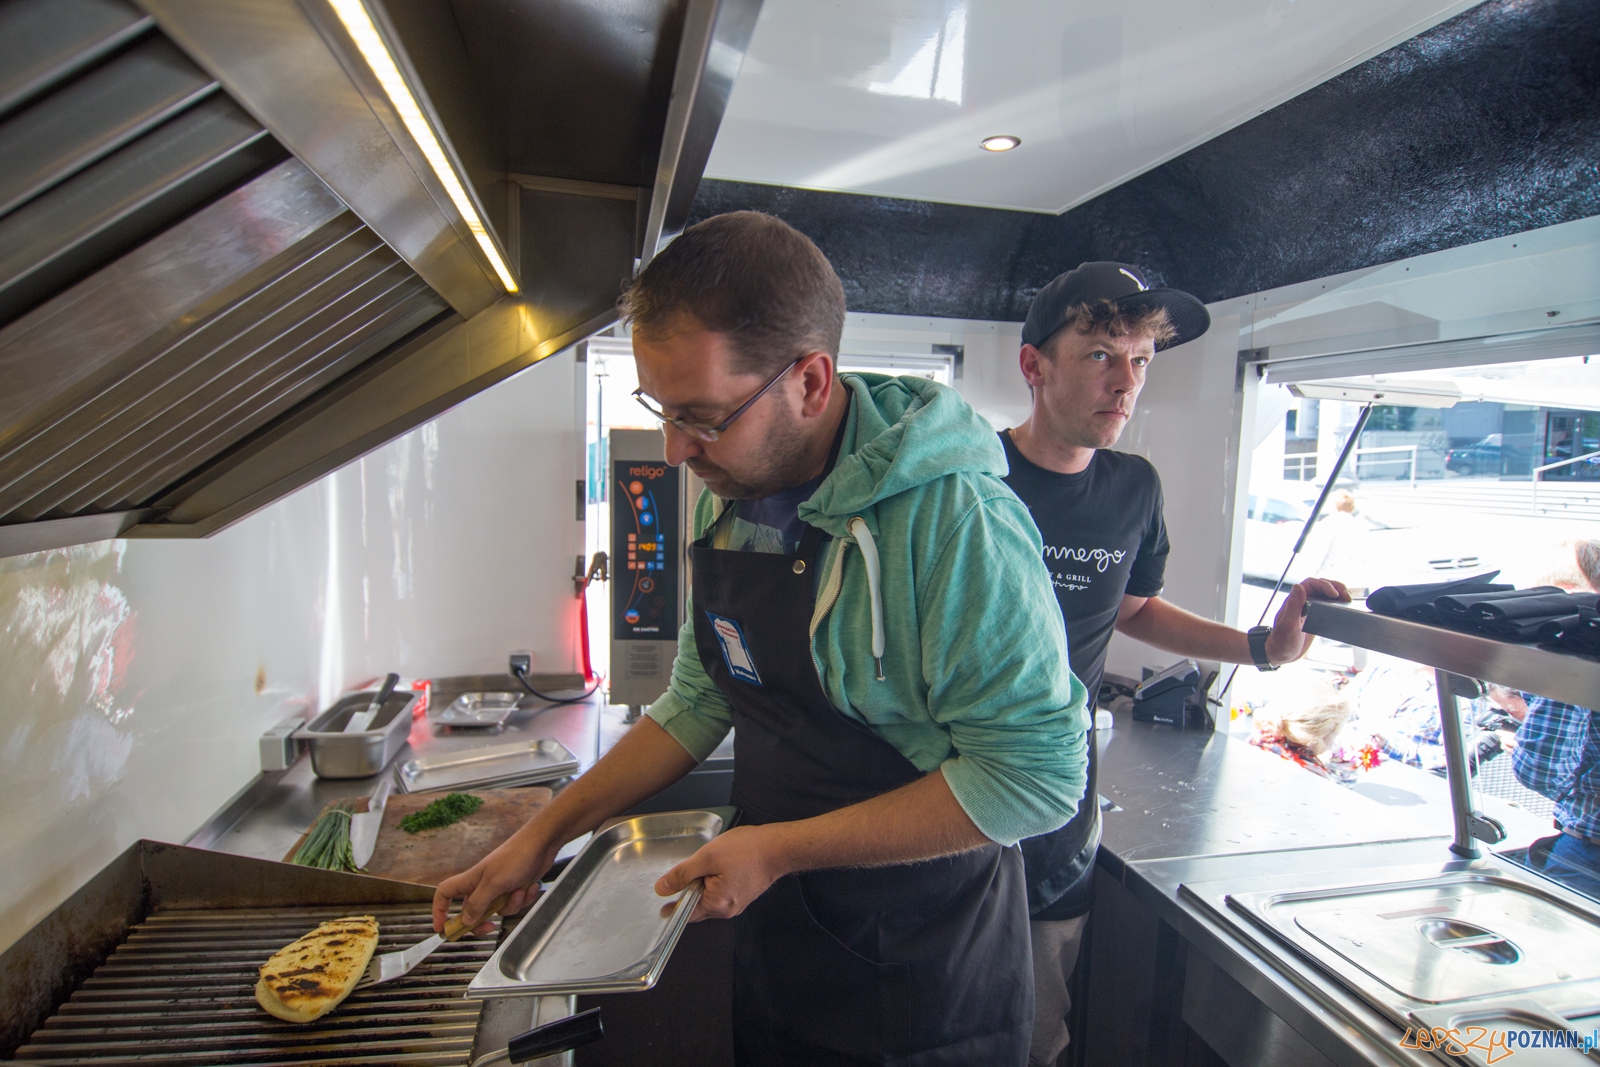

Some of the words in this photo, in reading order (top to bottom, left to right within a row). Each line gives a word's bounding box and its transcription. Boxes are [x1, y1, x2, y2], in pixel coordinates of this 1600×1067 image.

[629, 465, 665, 480] retigo
[1042, 545, 1127, 573] nnego
[1056, 572, 1063, 580] &
[1065, 573, 1092, 583] GRILL
